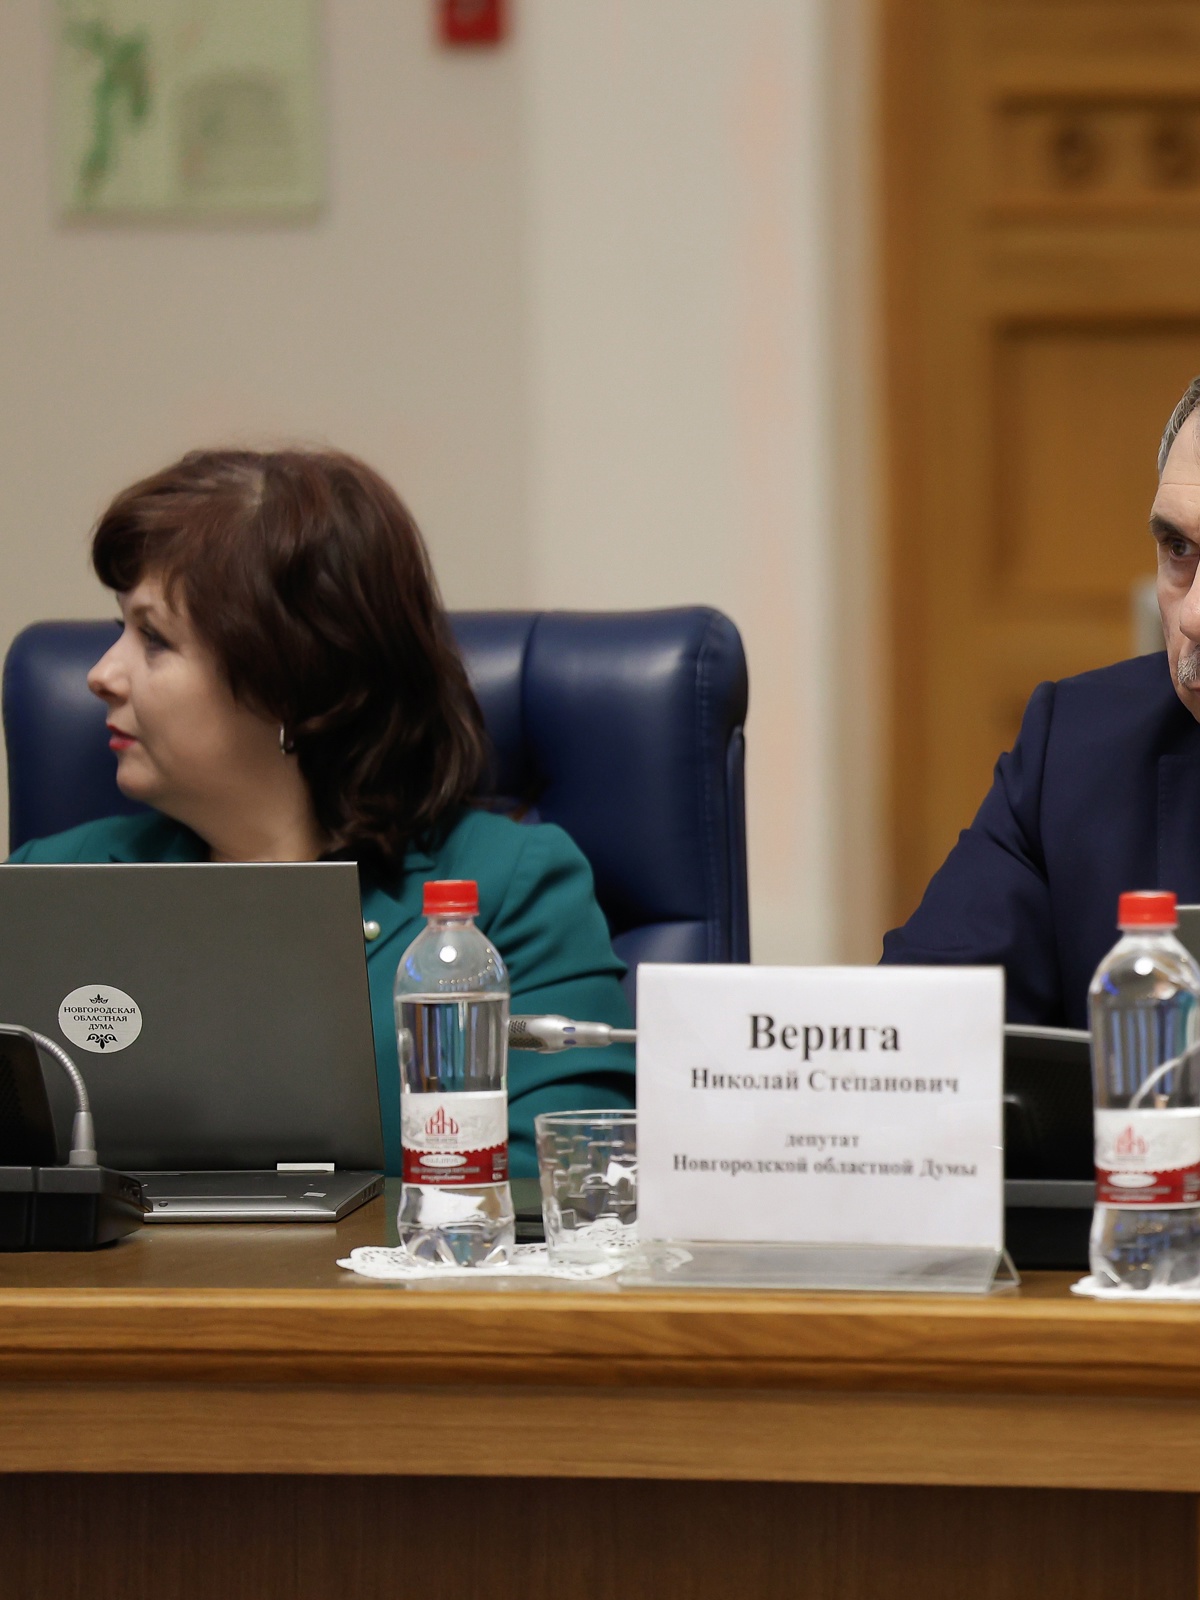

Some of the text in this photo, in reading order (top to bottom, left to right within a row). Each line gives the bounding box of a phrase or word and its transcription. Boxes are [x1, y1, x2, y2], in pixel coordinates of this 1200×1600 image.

[64, 1006, 136, 1014] НОВГОРОДСКАЯ
[88, 1023, 114, 1031] ДУМА
[749, 1013, 900, 1061] Верига
[691, 1067, 959, 1094] Николай Степанович
[785, 1132, 860, 1152] депутат
[673, 1153, 978, 1182] Новгородской областной Думы
